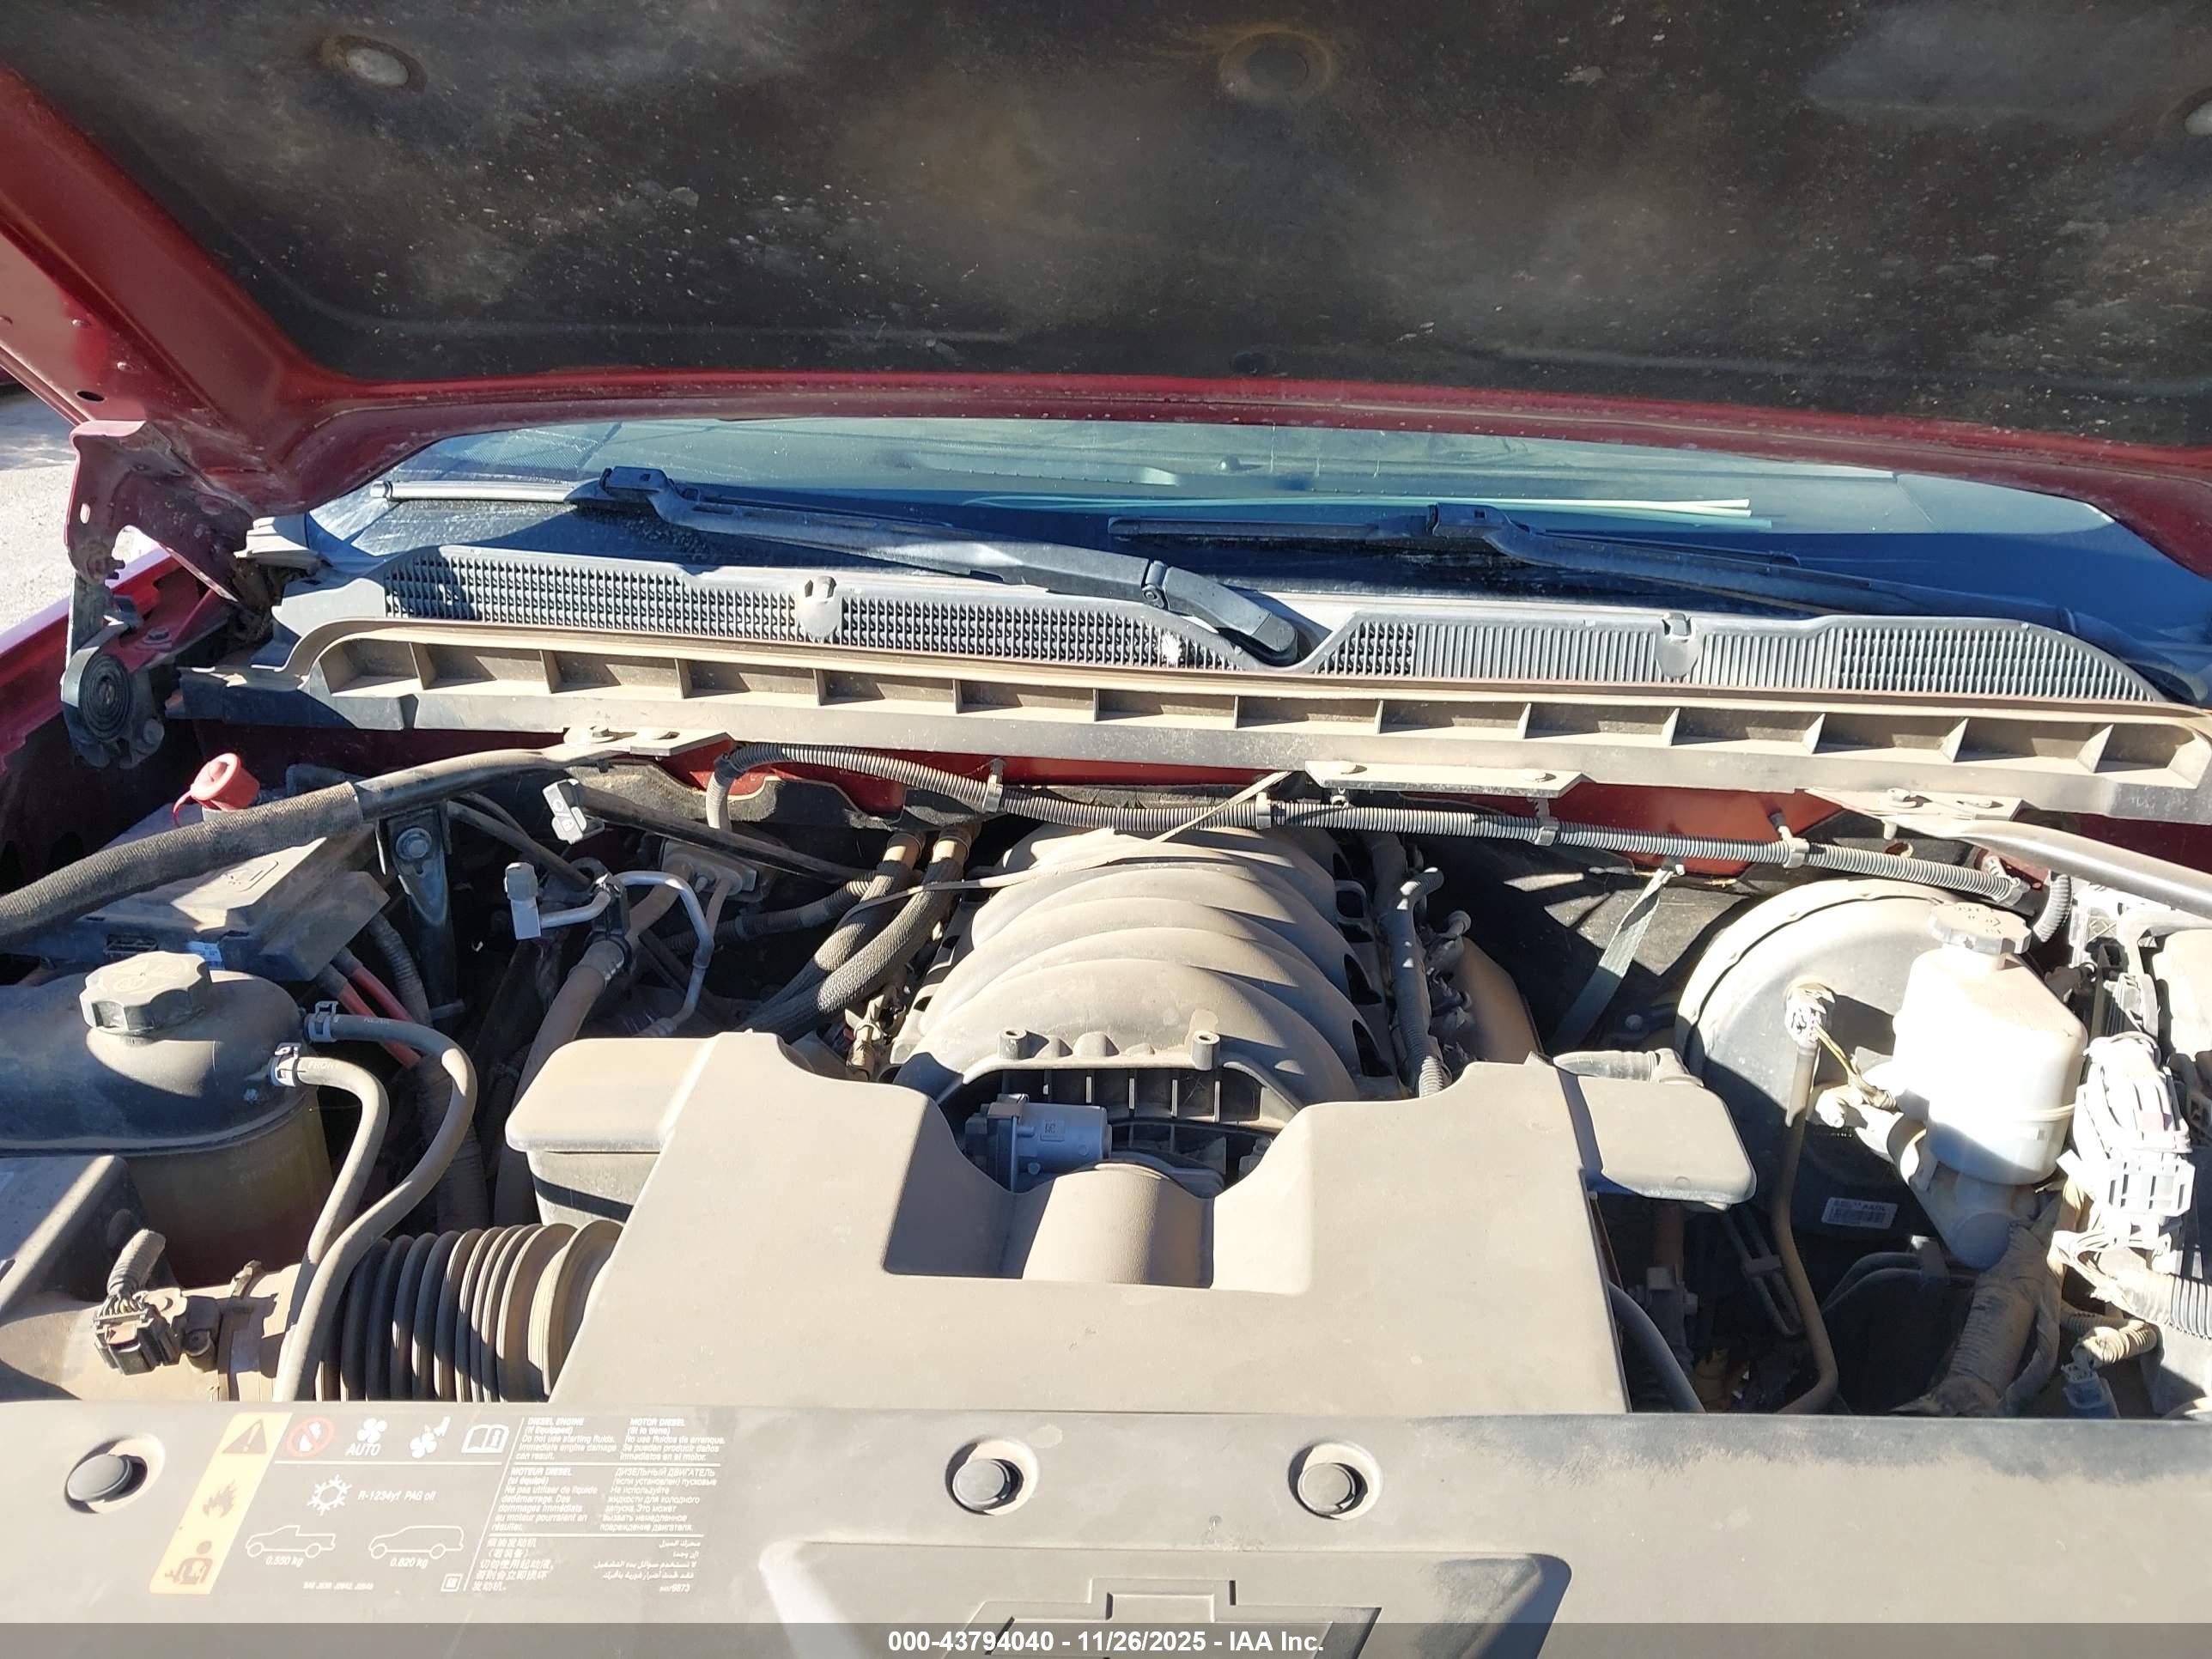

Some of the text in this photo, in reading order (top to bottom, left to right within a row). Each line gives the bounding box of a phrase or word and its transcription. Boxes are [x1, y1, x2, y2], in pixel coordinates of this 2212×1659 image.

[527, 1417, 585, 1426] DIESEL ENGINE
[629, 1417, 686, 1427] MOTOR DIESEL
[640, 1426, 647, 1435] lo
[648, 1426, 671, 1436] tiene)
[562, 1435, 592, 1444] starting
[625, 1435, 635, 1443] No
[652, 1435, 678, 1443] fluidos
[679, 1435, 690, 1443] de
[690, 1436, 726, 1446] arranque.
[344, 1443, 381, 1456] AUTO
[518, 1443, 617, 1453] Immediate engine damage
[622, 1443, 720, 1454] Se pueden producir daños
[531, 1452, 555, 1461] result.
[683, 1453, 706, 1462] motor.
[511, 1467, 572, 1476] MOTEUR DIESEL
[615, 1467, 715, 1477] ДИЗЕЛЬНЫЙ ДВИГАТЕЛЬ
[682, 1479, 718, 1487] пусковые
[504, 1486, 598, 1495] Ne pas utiliser de liquide
[623, 1486, 670, 1495] используйте
[357, 1490, 436, 1502] R-1234yf PAG oil
[660, 1496, 701, 1504] холодного
[498, 1504, 541, 1513] dommages
[652, 1504, 678, 1513] может
[535, 1514, 576, 1523] pourraient
[491, 1522, 522, 1531] résulter.
[599, 1523, 652, 1532] повреждение
[291, 1557, 304, 1568] kg
[390, 1557, 428, 1570] 0.820 kg
